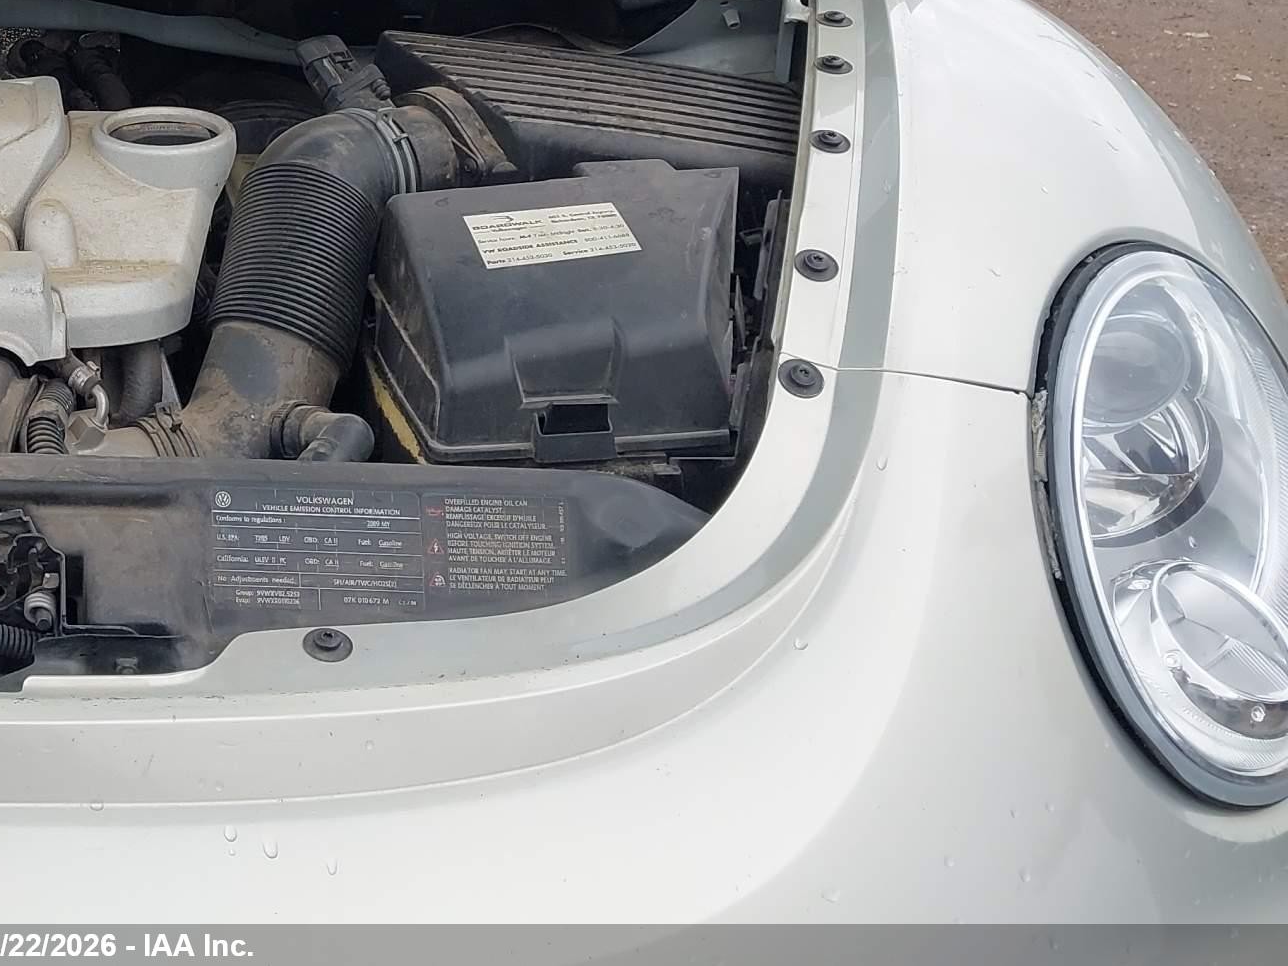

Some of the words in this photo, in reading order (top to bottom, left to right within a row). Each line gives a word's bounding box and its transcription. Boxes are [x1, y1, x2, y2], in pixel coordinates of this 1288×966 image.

[472, 220, 544, 230] BOARDWALK
[536, 239, 578, 248] ASSISTANCE
[296, 496, 353, 505] VOLKSWAGEN
[262, 504, 288, 512] VEHICLE
[290, 505, 320, 513] EMISSION
[322, 506, 352, 514] CONTROL
[216, 554, 249, 563] California:
